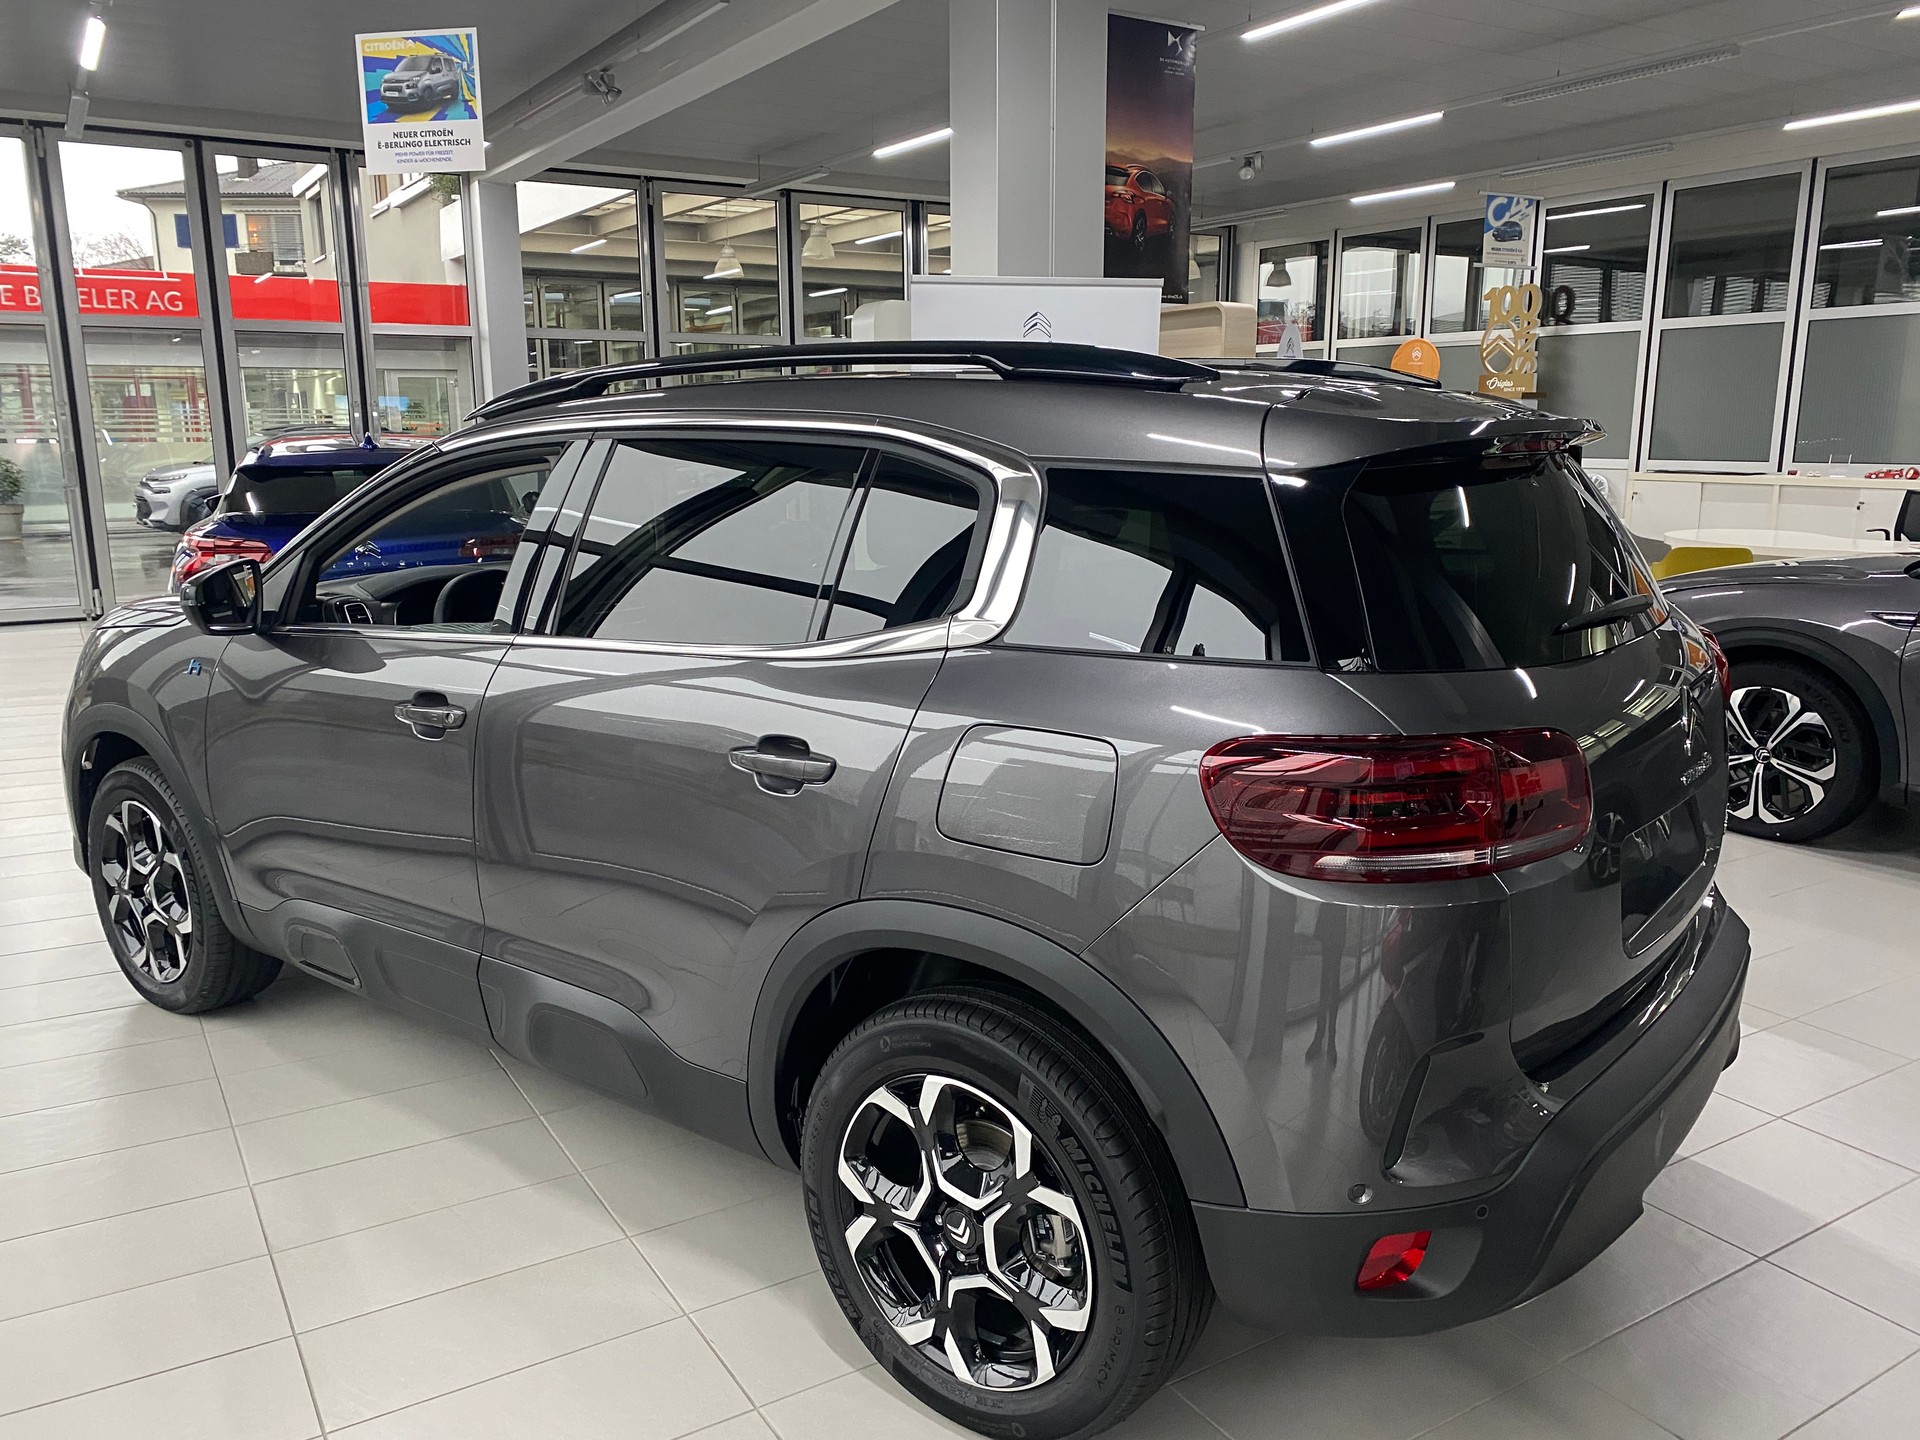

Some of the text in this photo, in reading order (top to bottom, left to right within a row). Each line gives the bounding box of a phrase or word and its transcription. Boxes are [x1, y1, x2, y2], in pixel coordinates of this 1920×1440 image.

[392, 127, 454, 139] NEUER CITROËN
[424, 138, 471, 148] ELEKTRISCH
[145, 290, 183, 312] AG
[1484, 284, 1542, 320] 100
[1061, 1135, 1133, 1294] MICHELIN
[806, 1183, 864, 1326] MICHELIN
